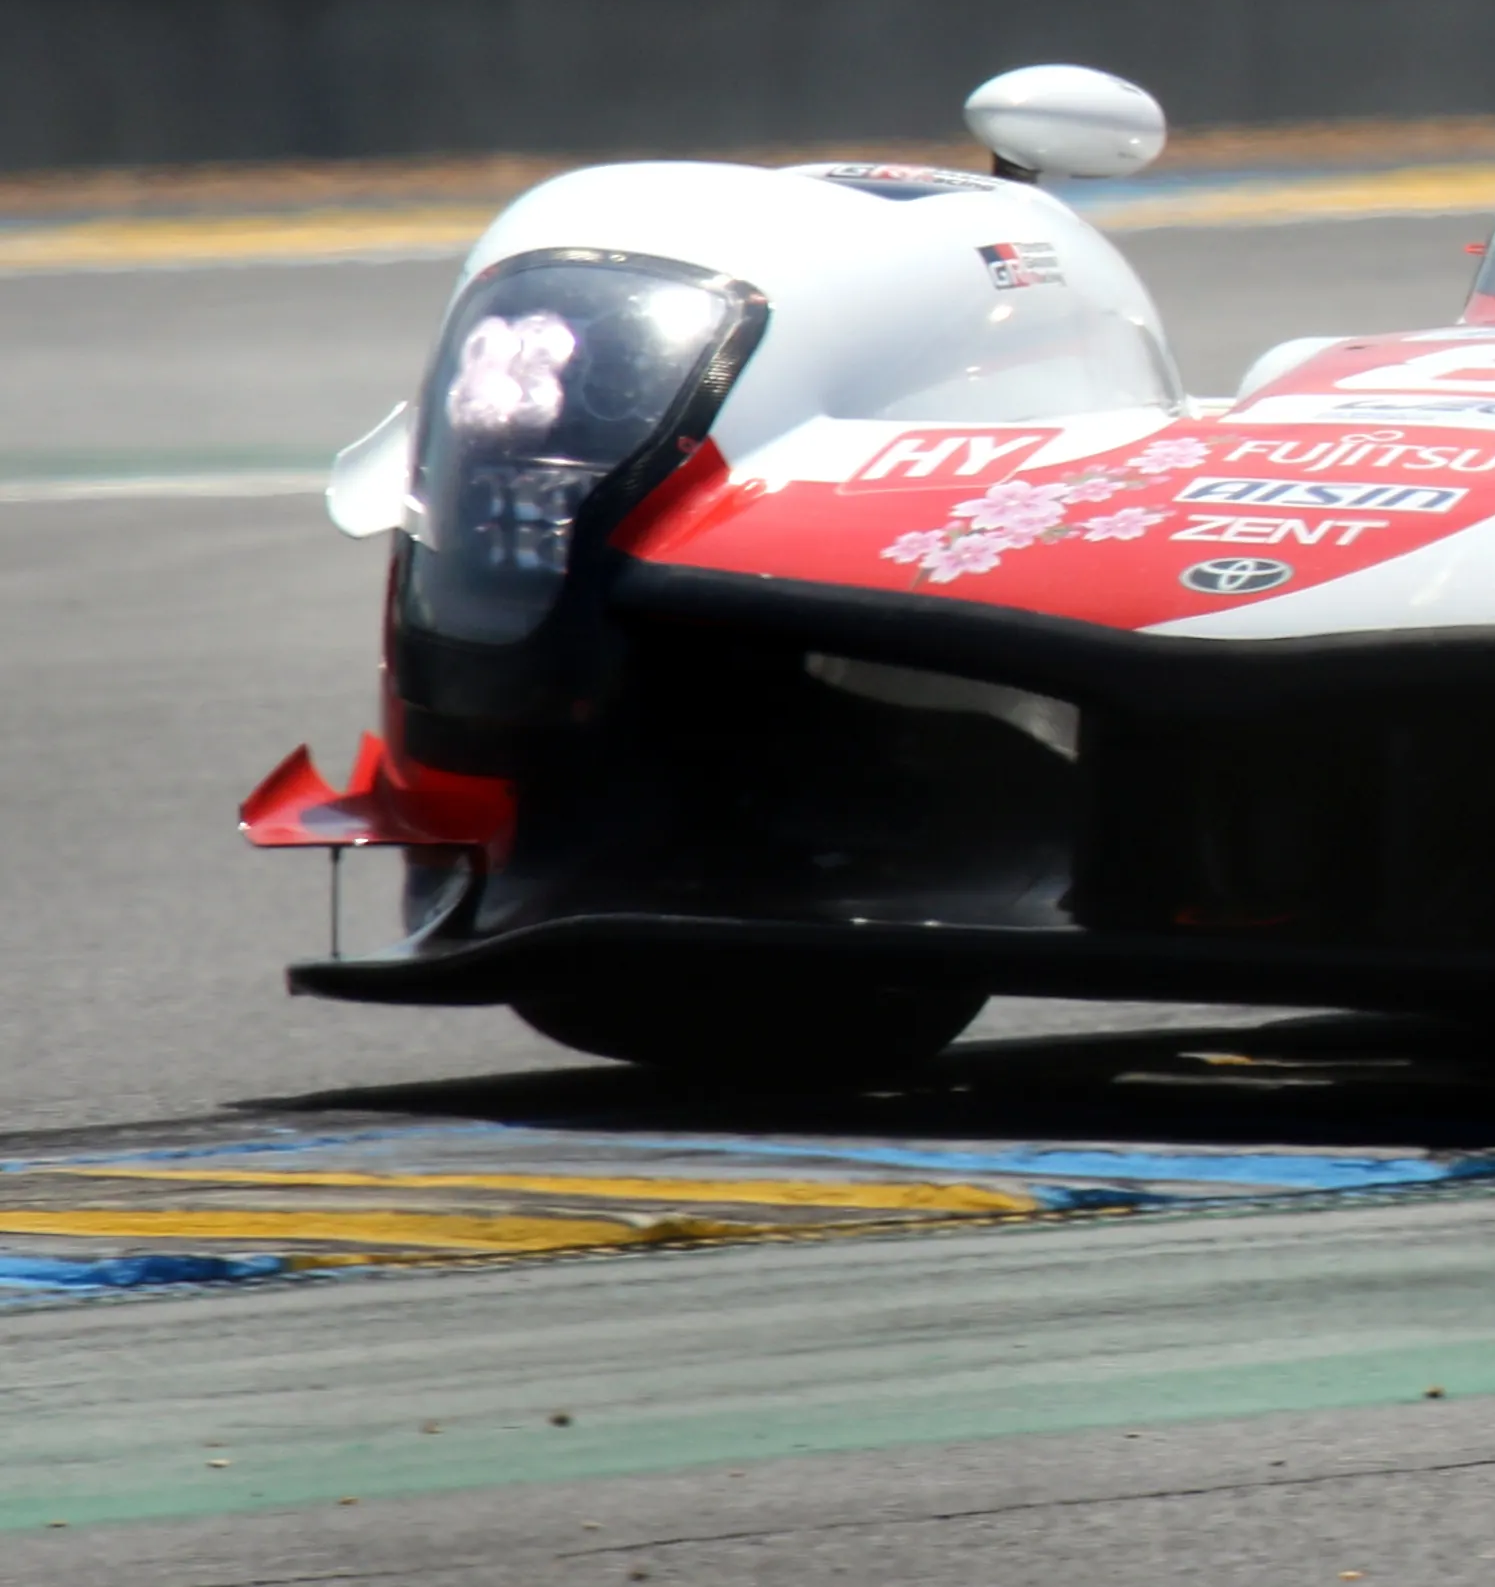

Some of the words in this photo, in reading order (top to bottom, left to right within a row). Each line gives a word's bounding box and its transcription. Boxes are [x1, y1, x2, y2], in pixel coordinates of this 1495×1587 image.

[860, 434, 1045, 481] HY
[1187, 479, 1457, 510] AISIN
[1168, 514, 1391, 547] ZENT
